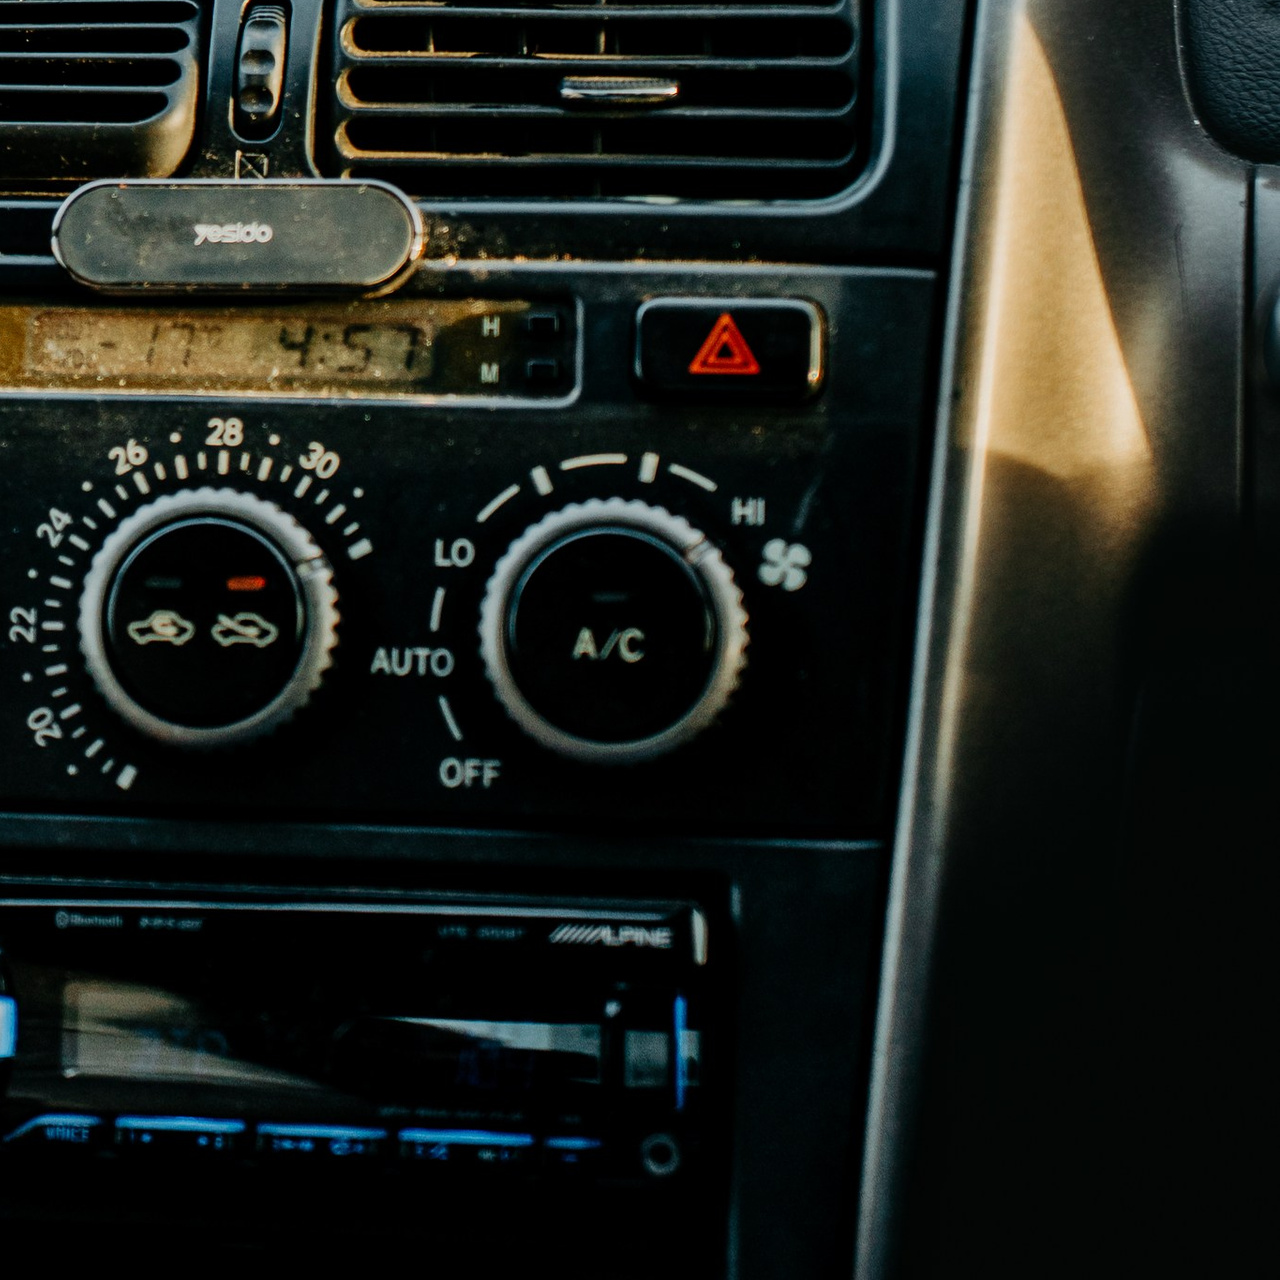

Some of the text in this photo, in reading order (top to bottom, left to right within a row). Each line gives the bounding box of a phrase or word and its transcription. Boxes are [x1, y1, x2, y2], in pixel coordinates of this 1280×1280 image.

[193, 221, 273, 246] yesido
[482, 316, 500, 337] H
[279, 324, 420, 373] 4:57
[481, 362, 500, 384] M
[205, 418, 244, 447] 28
[108, 439, 148, 476] 26
[299, 441, 340, 479] 30
[731, 497, 767, 527] HI
[36, 507, 72, 549] 24
[434, 539, 476, 568] LO
[9, 606, 38, 644] 22
[571, 626, 645, 664] A/C
[370, 647, 455, 678] AUTO
[27, 707, 63, 748] 20
[439, 757, 501, 788] OFF
